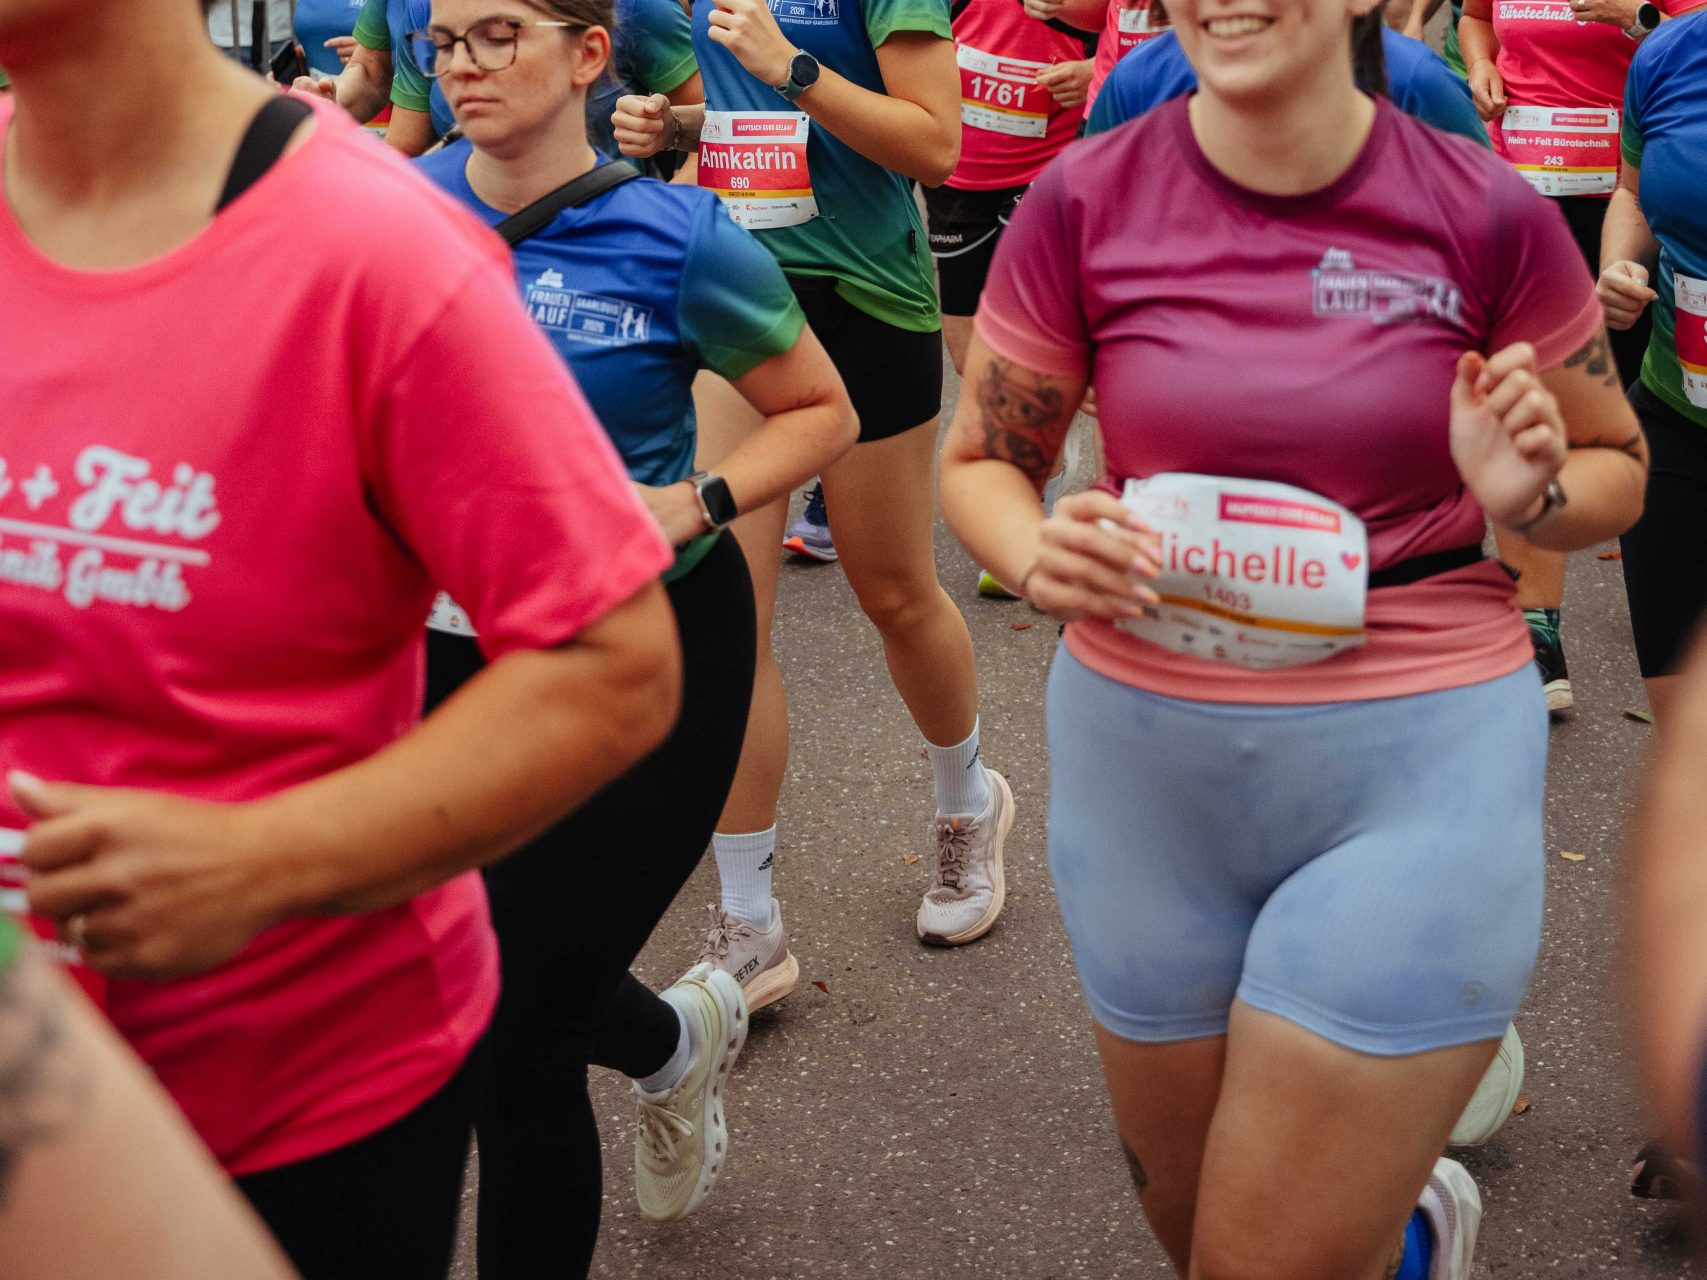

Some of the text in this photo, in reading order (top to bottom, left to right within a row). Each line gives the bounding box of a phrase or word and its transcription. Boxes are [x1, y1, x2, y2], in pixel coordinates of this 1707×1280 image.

[767, 0, 780, 11] UF
[1499, 4, 1574, 21] Bürotechnik
[970, 76, 1026, 108] 1761
[1507, 136, 1527, 145] Heim
[1553, 137, 1610, 148] Bürotechnik
[701, 144, 797, 170] Annkatrin
[1544, 155, 1563, 166] 243
[730, 176, 750, 189] 690
[69, 445, 222, 540] Feit
[1158, 531, 1327, 589] ichelle
[732, 955, 759, 983] RE-TEX
